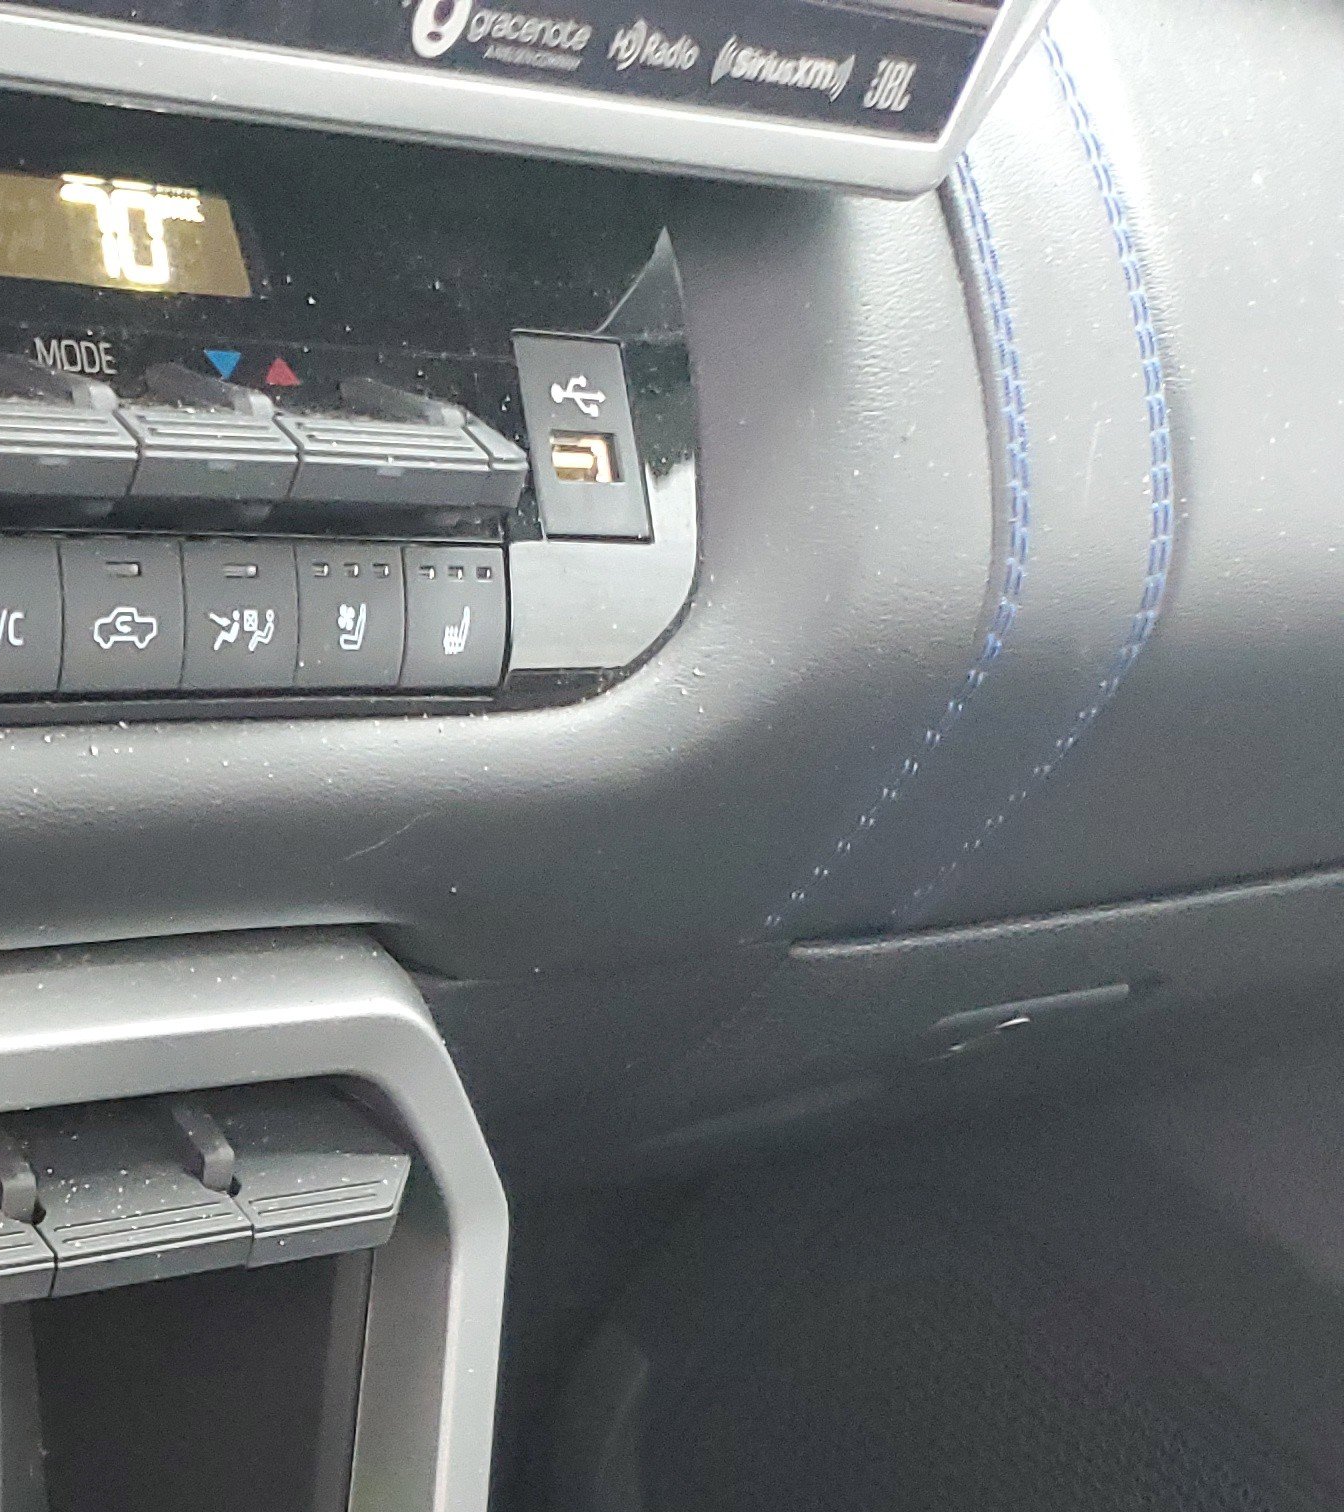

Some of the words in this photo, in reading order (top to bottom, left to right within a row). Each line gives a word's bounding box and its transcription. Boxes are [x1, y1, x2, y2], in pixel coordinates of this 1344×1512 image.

[467, 9, 592, 50] gracenote
[640, 32, 700, 70] Radio
[863, 57, 916, 112] JBL
[34, 337, 117, 376] MODE
